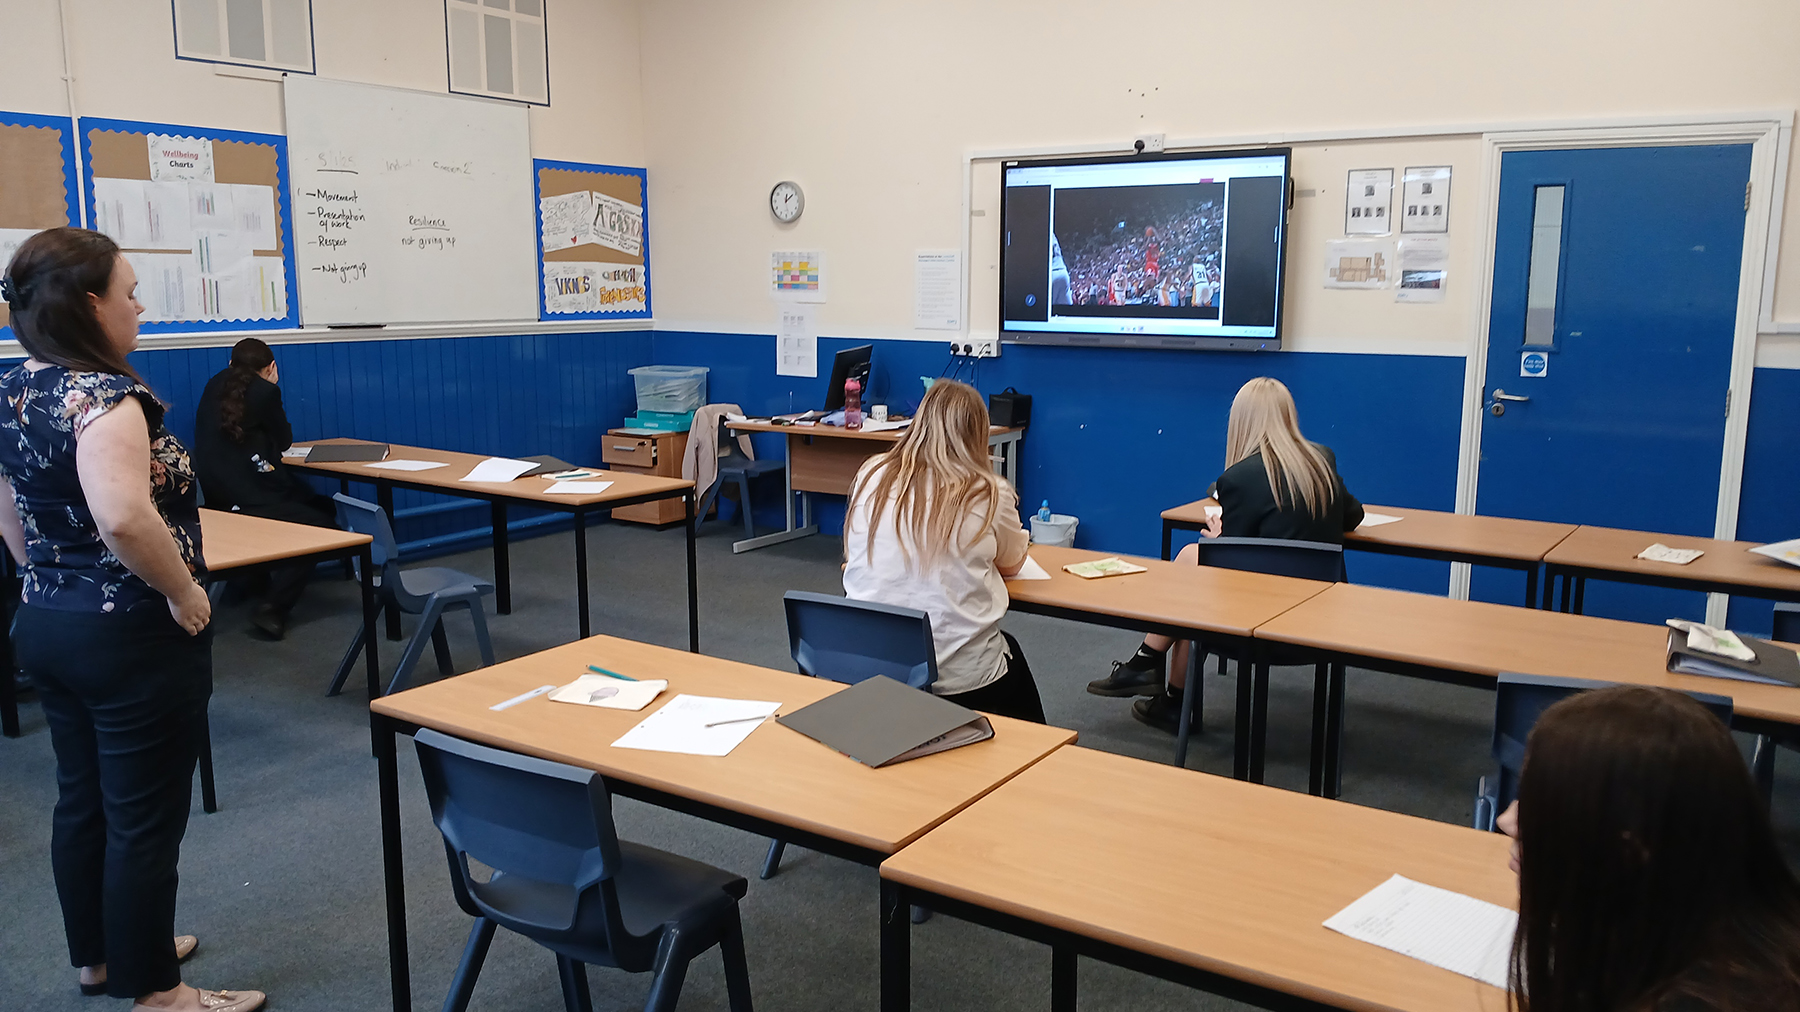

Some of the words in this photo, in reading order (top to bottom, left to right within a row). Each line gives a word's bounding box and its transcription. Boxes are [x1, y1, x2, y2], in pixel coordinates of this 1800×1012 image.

[162, 150, 199, 160] Wellbeing
[169, 160, 194, 168] Charts
[401, 235, 416, 245] not
[418, 234, 444, 251] giving
